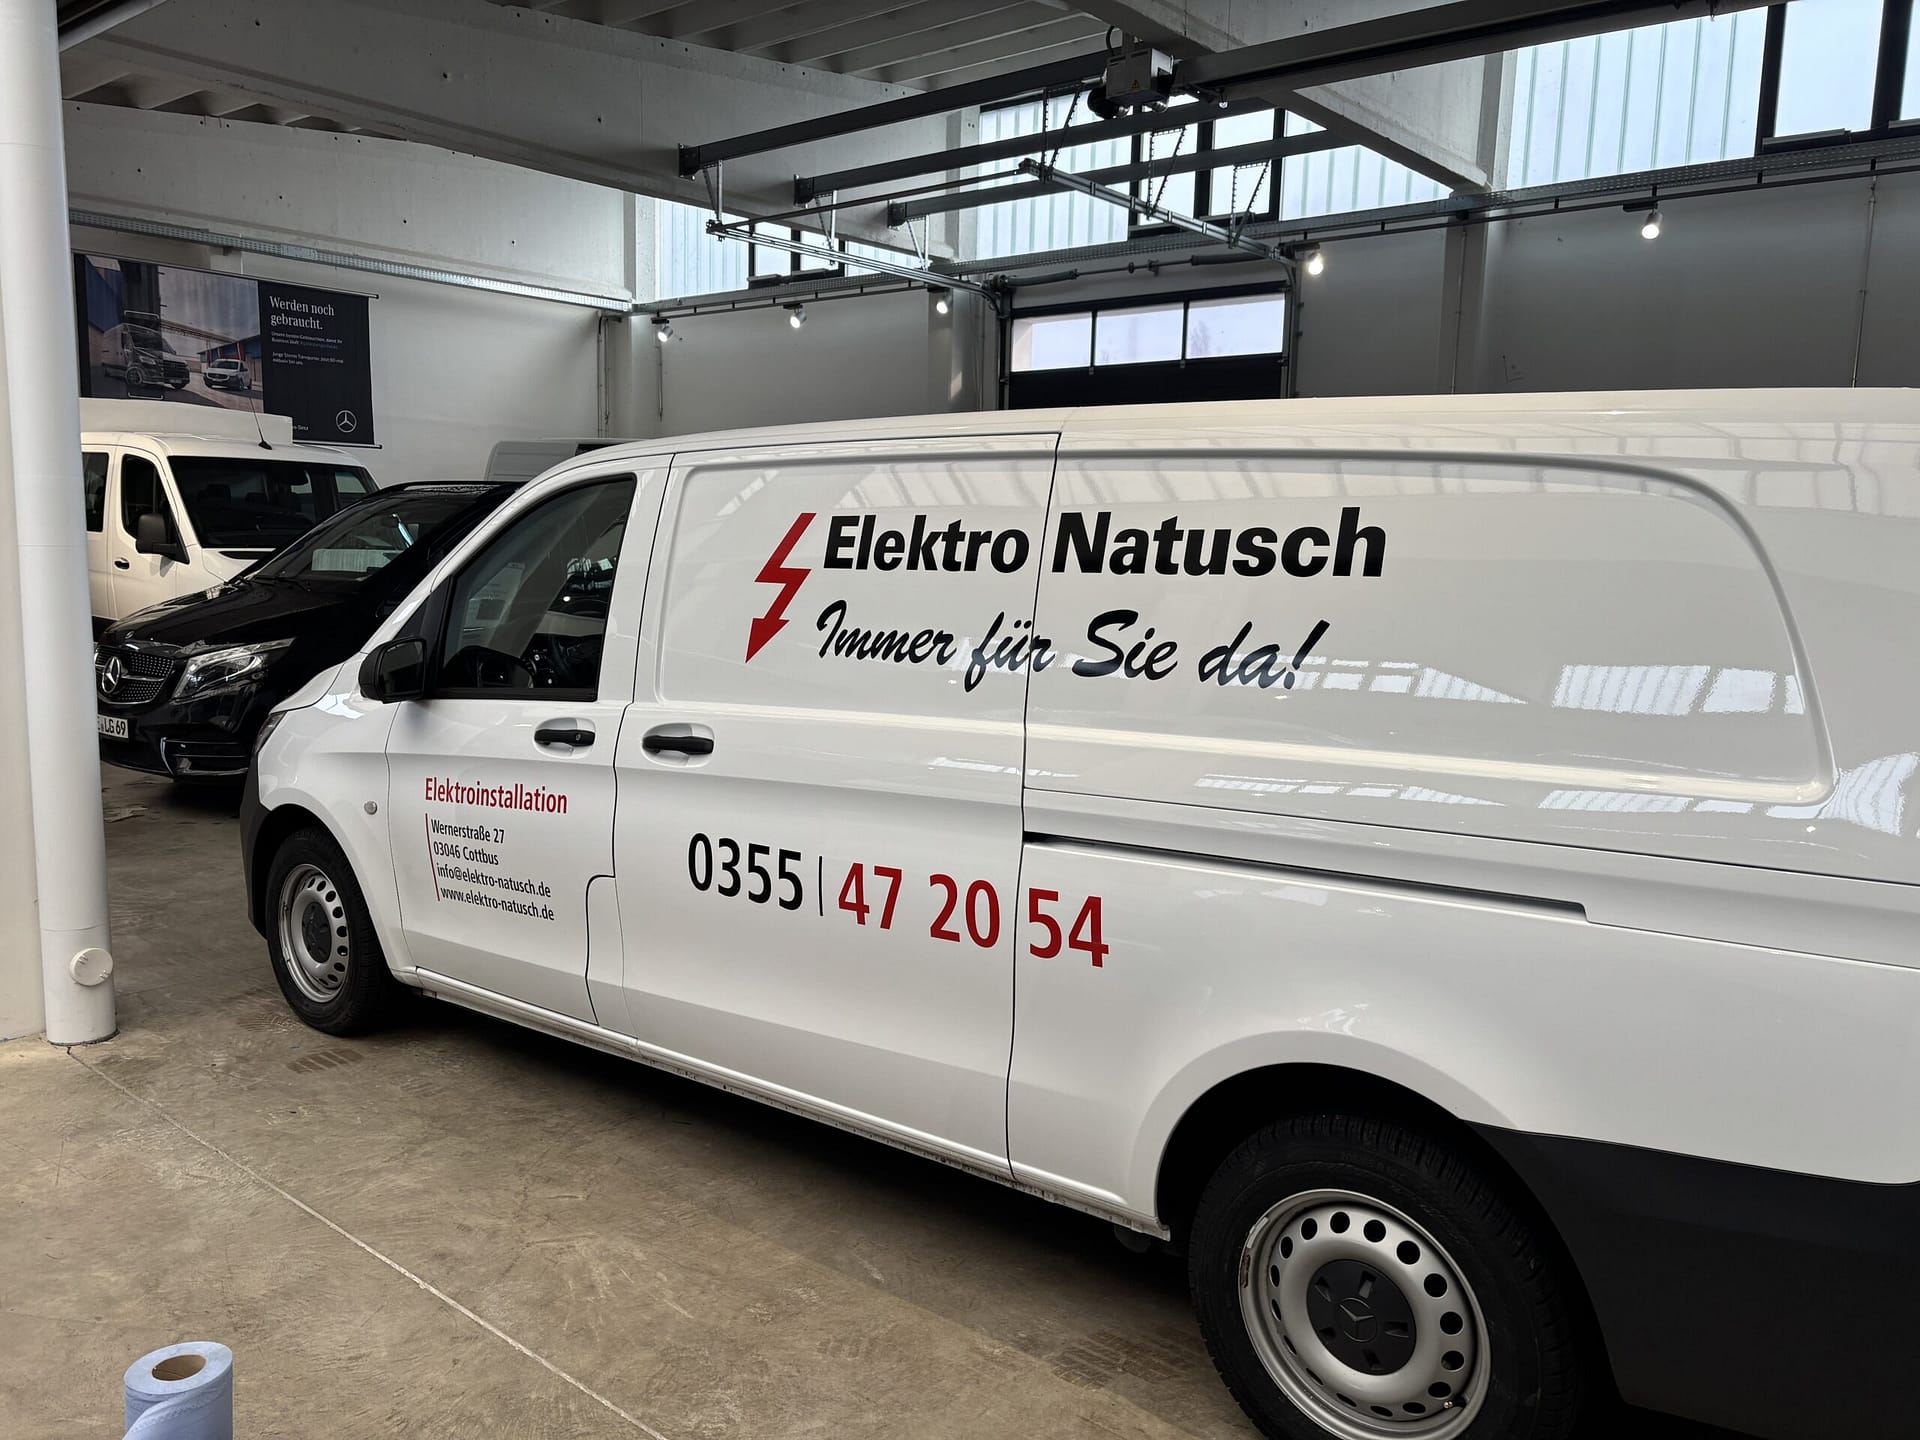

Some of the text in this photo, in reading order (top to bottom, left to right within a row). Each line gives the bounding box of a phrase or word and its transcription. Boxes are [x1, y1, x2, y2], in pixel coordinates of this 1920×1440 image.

[270, 296, 334, 316] Werden noch
[271, 314, 322, 329] gebraucht.
[824, 507, 1385, 577] Elektro Natusch
[817, 600, 1330, 695] Immer für Sie da!
[426, 777, 567, 814] Elektroinstallation
[430, 819, 504, 843] Wernerstraße 27
[433, 841, 498, 865] 03046 Cottbus
[437, 864, 551, 897] info@elektro-natusch.de
[441, 888, 554, 920] www.elektro-natusch.de
[689, 833, 1109, 968] 0355 47 20 54
